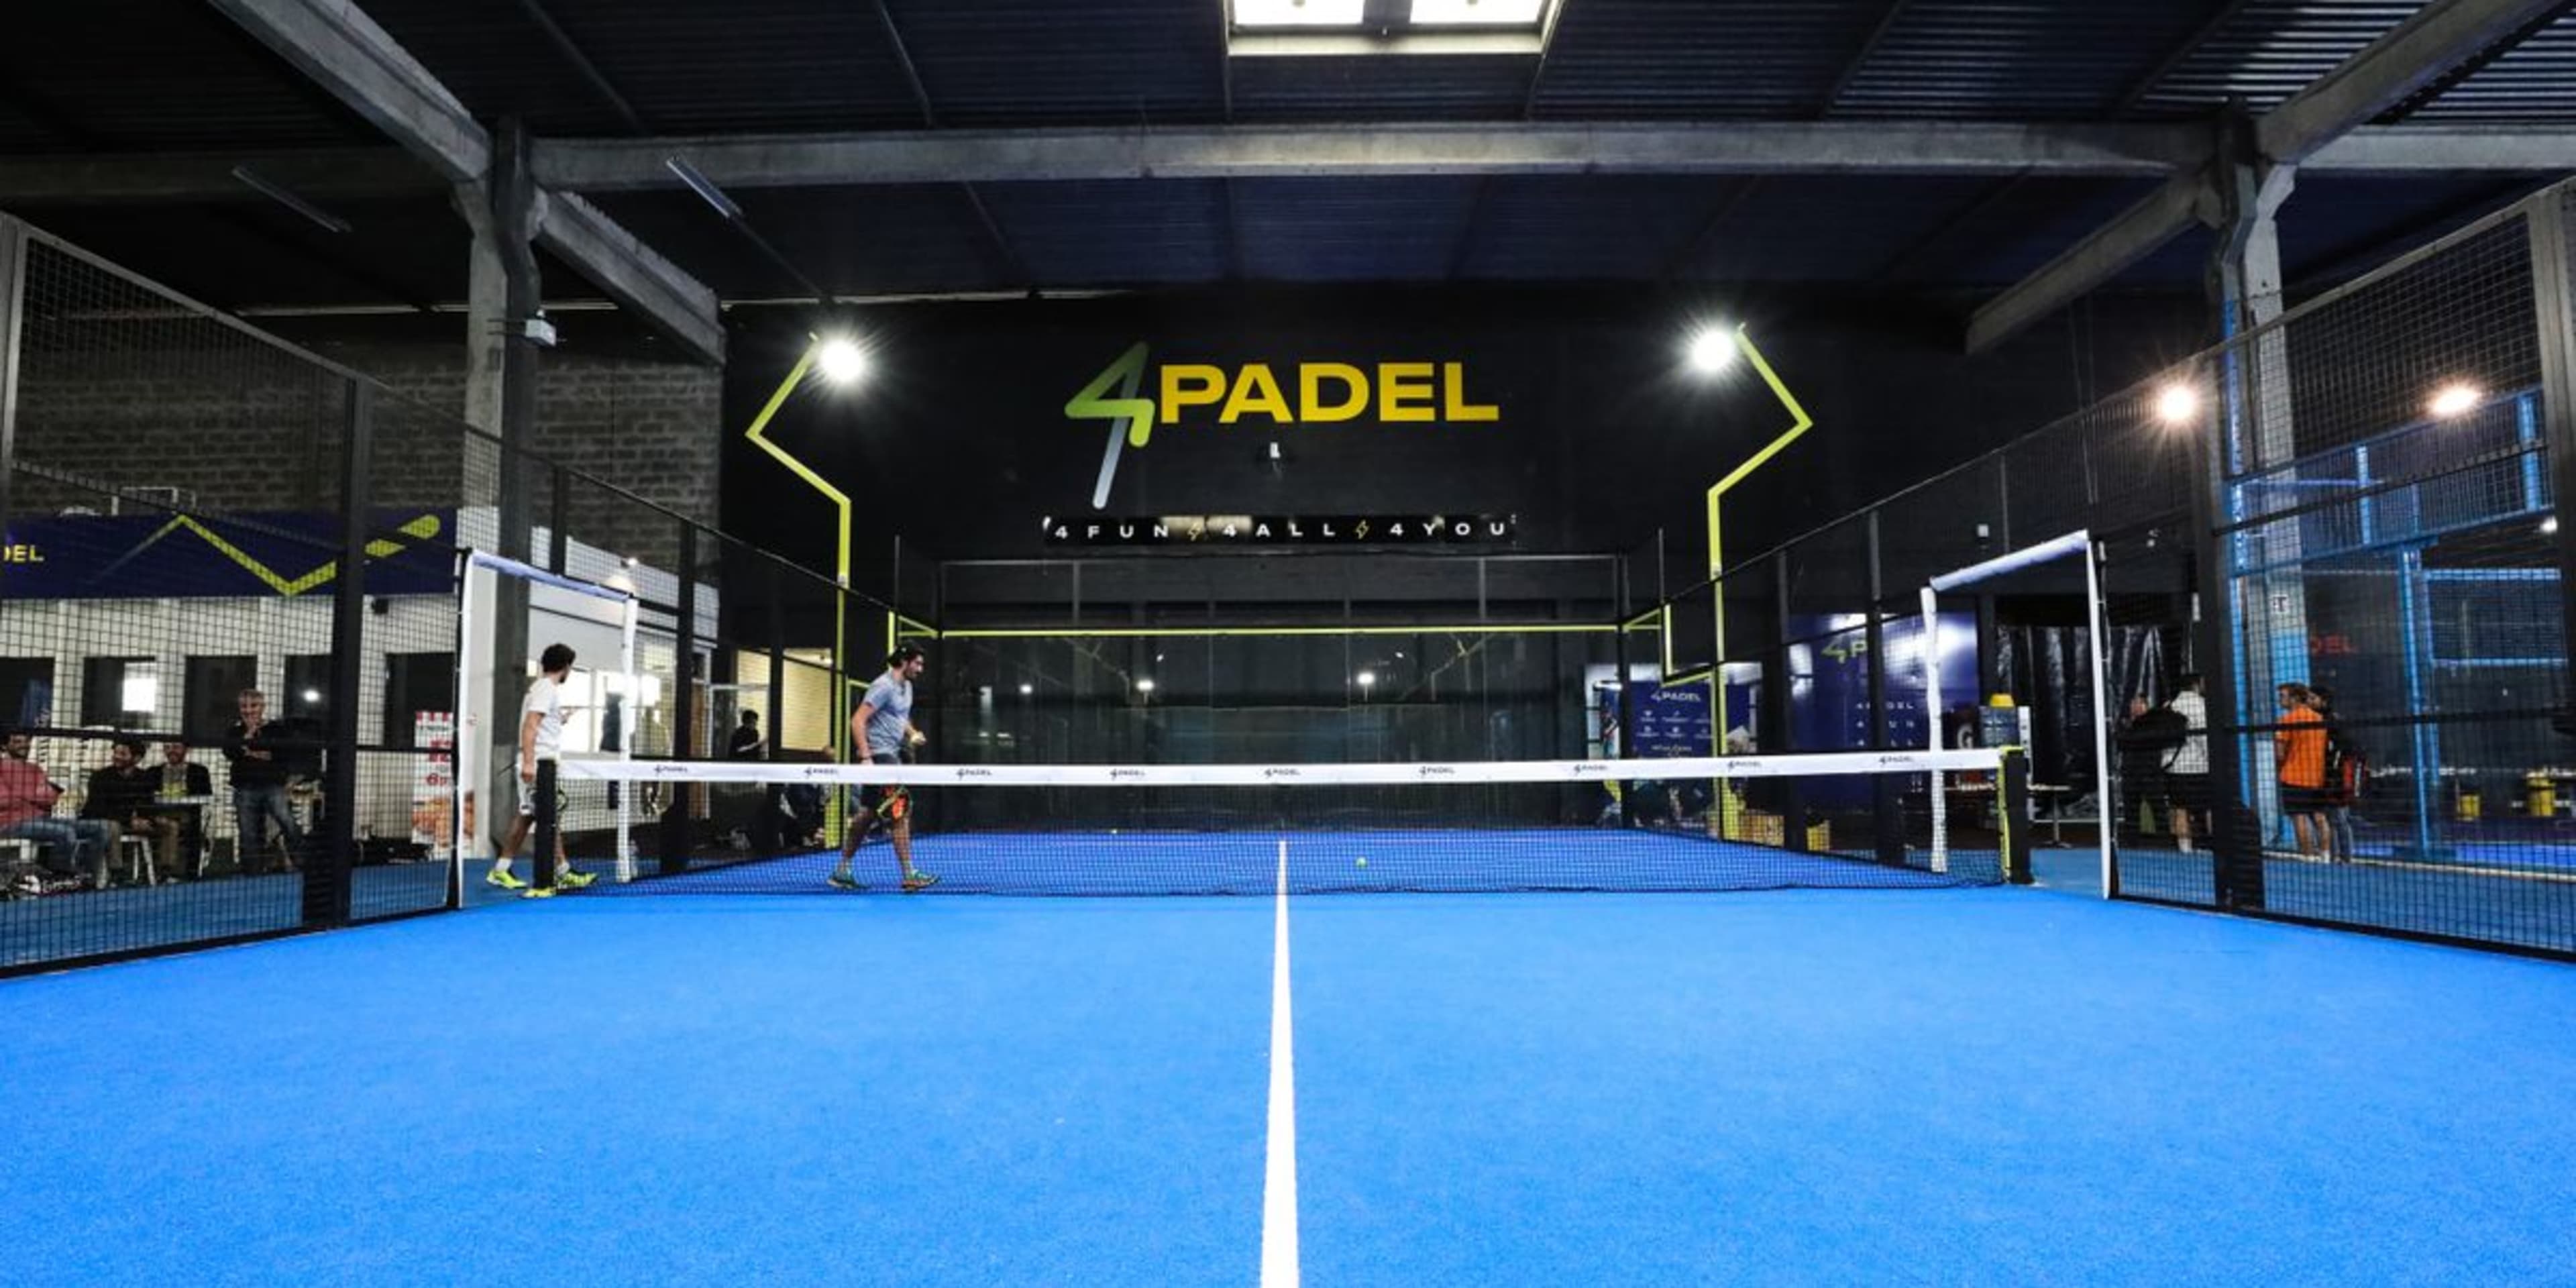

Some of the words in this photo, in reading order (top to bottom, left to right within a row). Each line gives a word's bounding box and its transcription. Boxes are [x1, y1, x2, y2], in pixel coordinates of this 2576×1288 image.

[1065, 342, 1499, 508] 4PADEL
[1055, 525, 1169, 539] 4FUN
[1223, 523, 1336, 537] 4ALL
[1390, 523, 1504, 535] 4YOU
